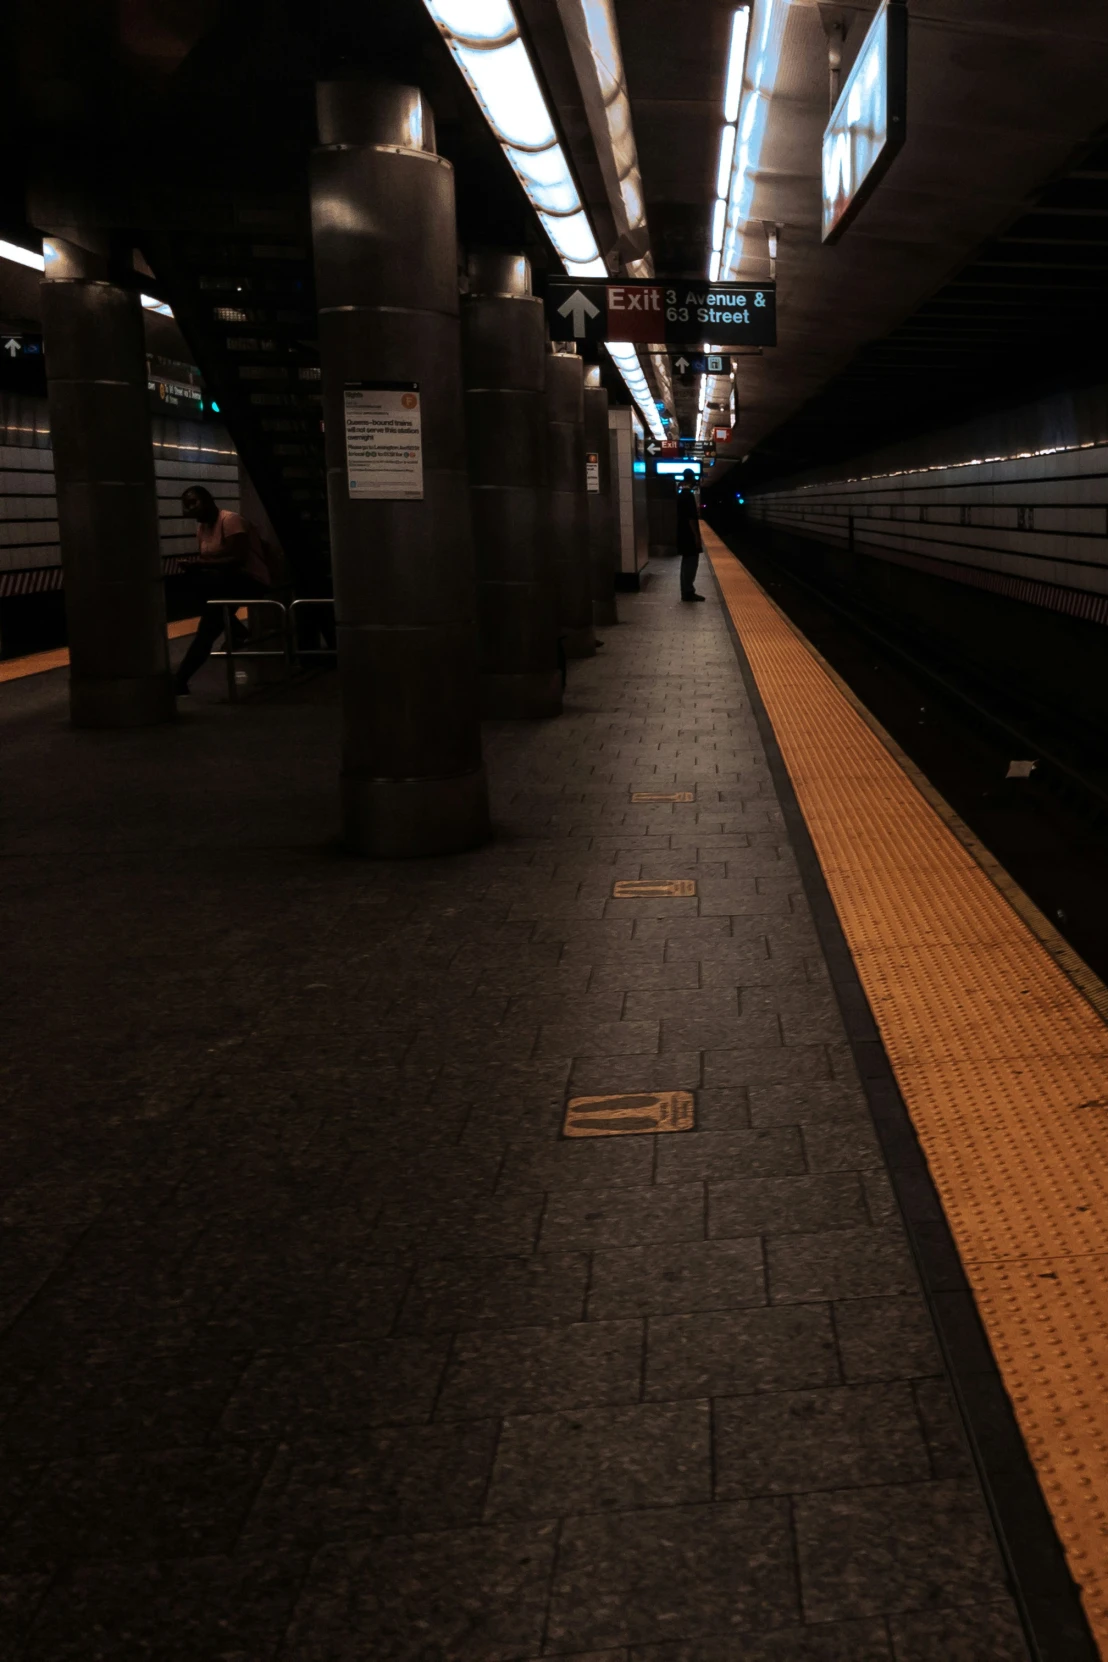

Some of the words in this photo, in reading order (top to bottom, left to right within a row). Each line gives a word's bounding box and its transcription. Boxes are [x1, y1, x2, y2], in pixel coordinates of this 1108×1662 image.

[608, 288, 660, 311] Exit
[665, 290, 677, 304] 3
[685, 291, 747, 307] Avenue
[753, 291, 766, 308] &
[666, 307, 690, 322] 63
[697, 308, 750, 324] Street
